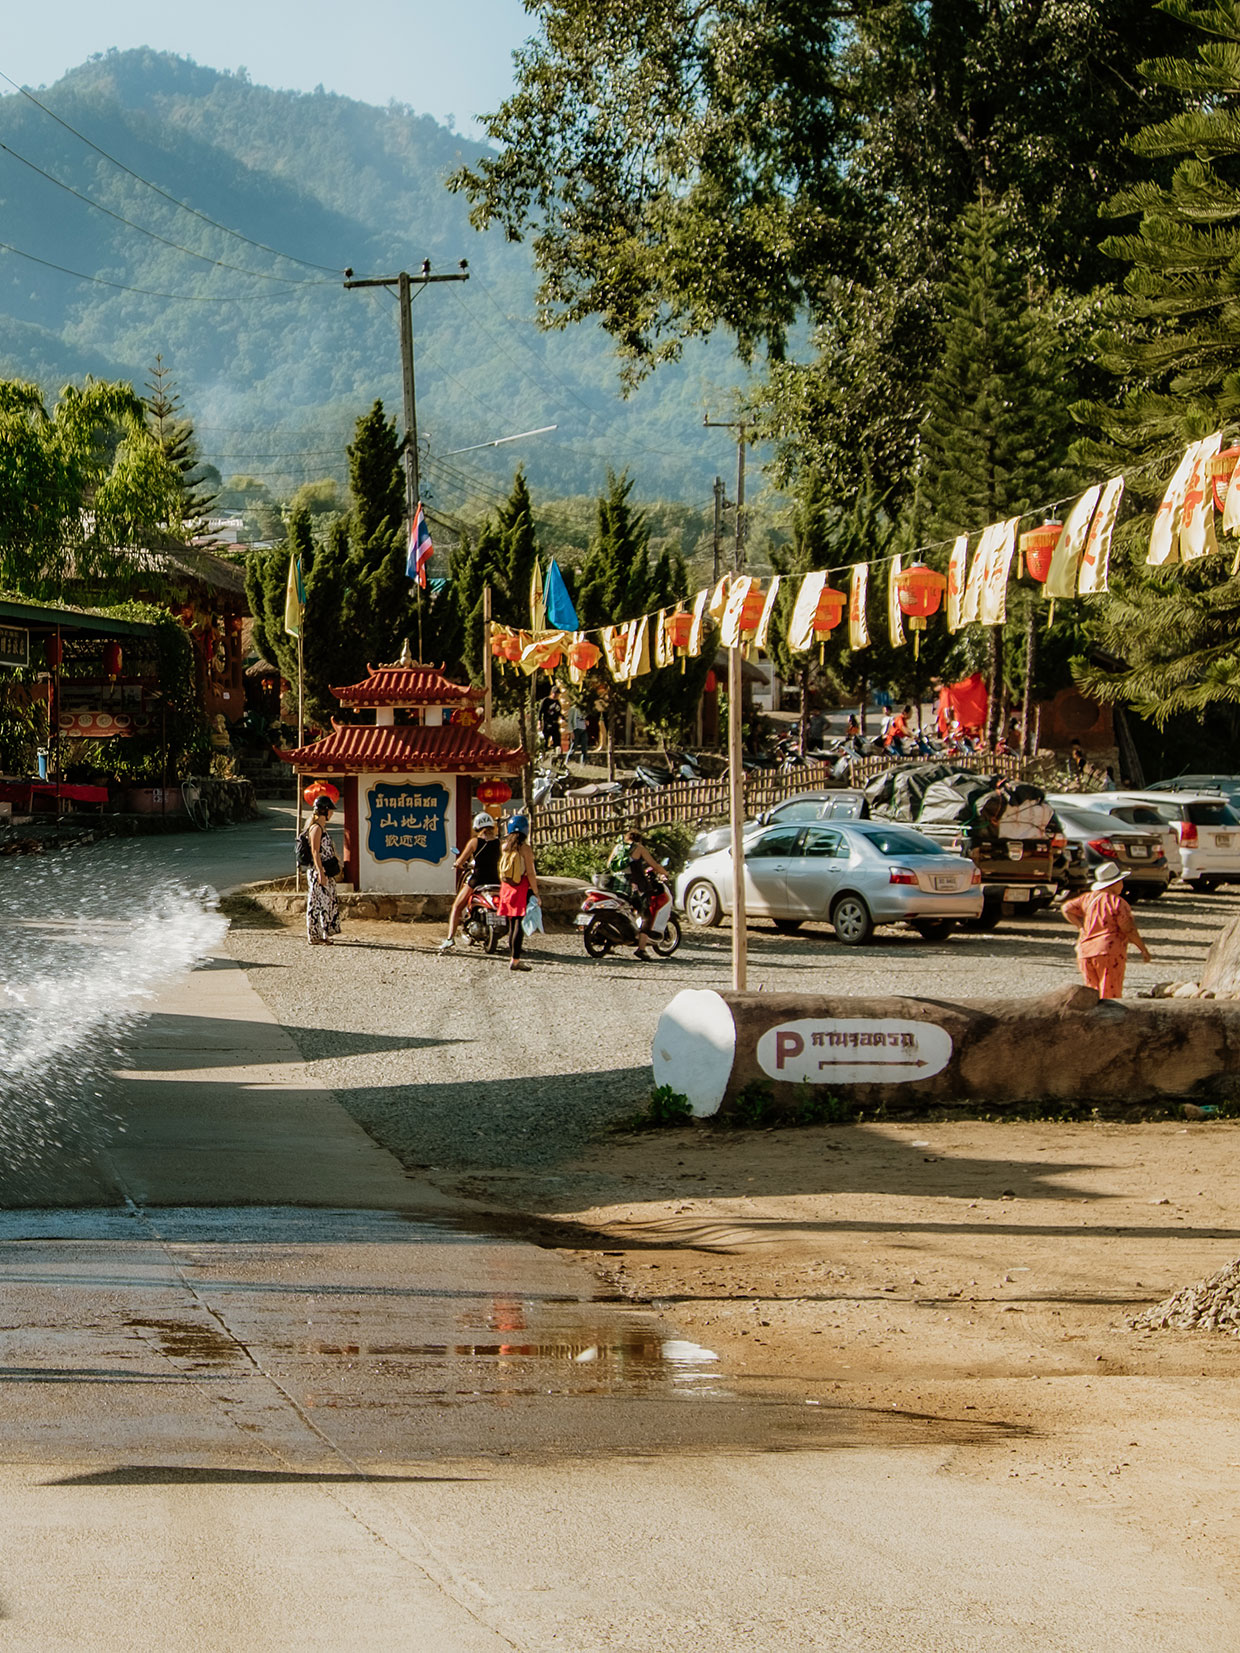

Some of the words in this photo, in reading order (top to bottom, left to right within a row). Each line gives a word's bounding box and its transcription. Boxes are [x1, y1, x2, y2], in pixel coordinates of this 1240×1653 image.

[380, 813, 439, 831] 山地村
[776, 1031, 805, 1069] P
